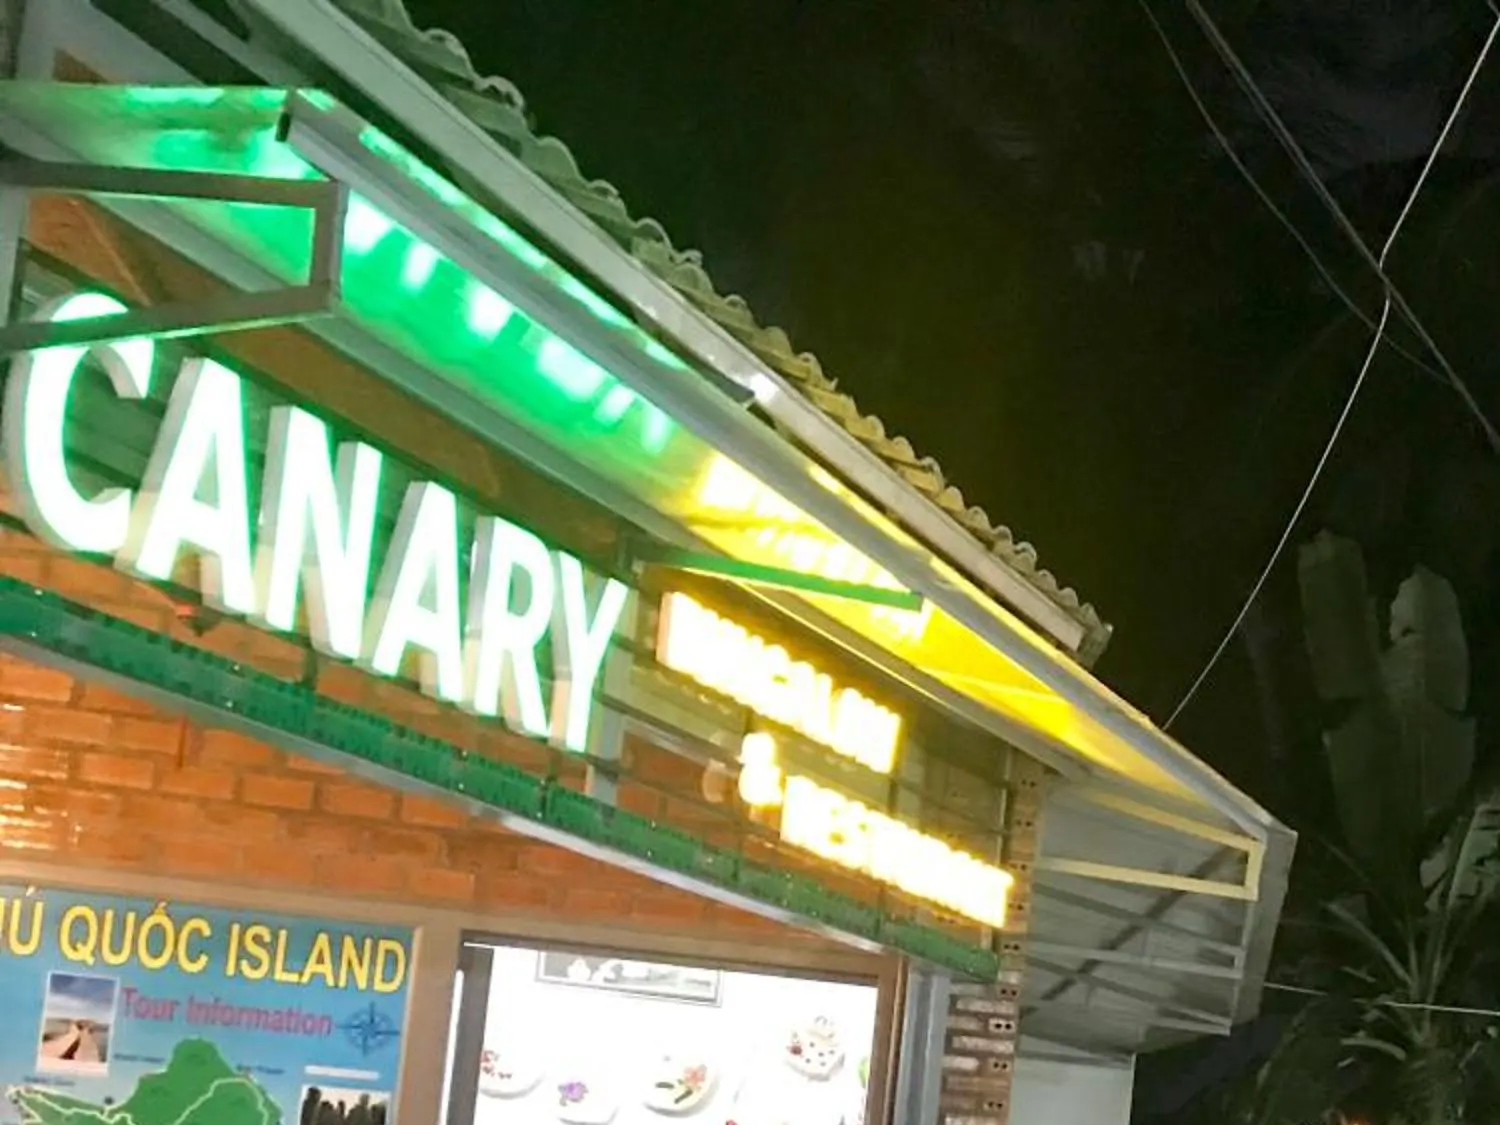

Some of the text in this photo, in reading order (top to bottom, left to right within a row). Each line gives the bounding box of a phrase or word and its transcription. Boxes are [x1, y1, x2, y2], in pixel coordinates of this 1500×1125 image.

[8, 291, 630, 753] CANARY
[224, 922, 408, 992] ISLAND
[122, 987, 333, 1036] Tour Information
